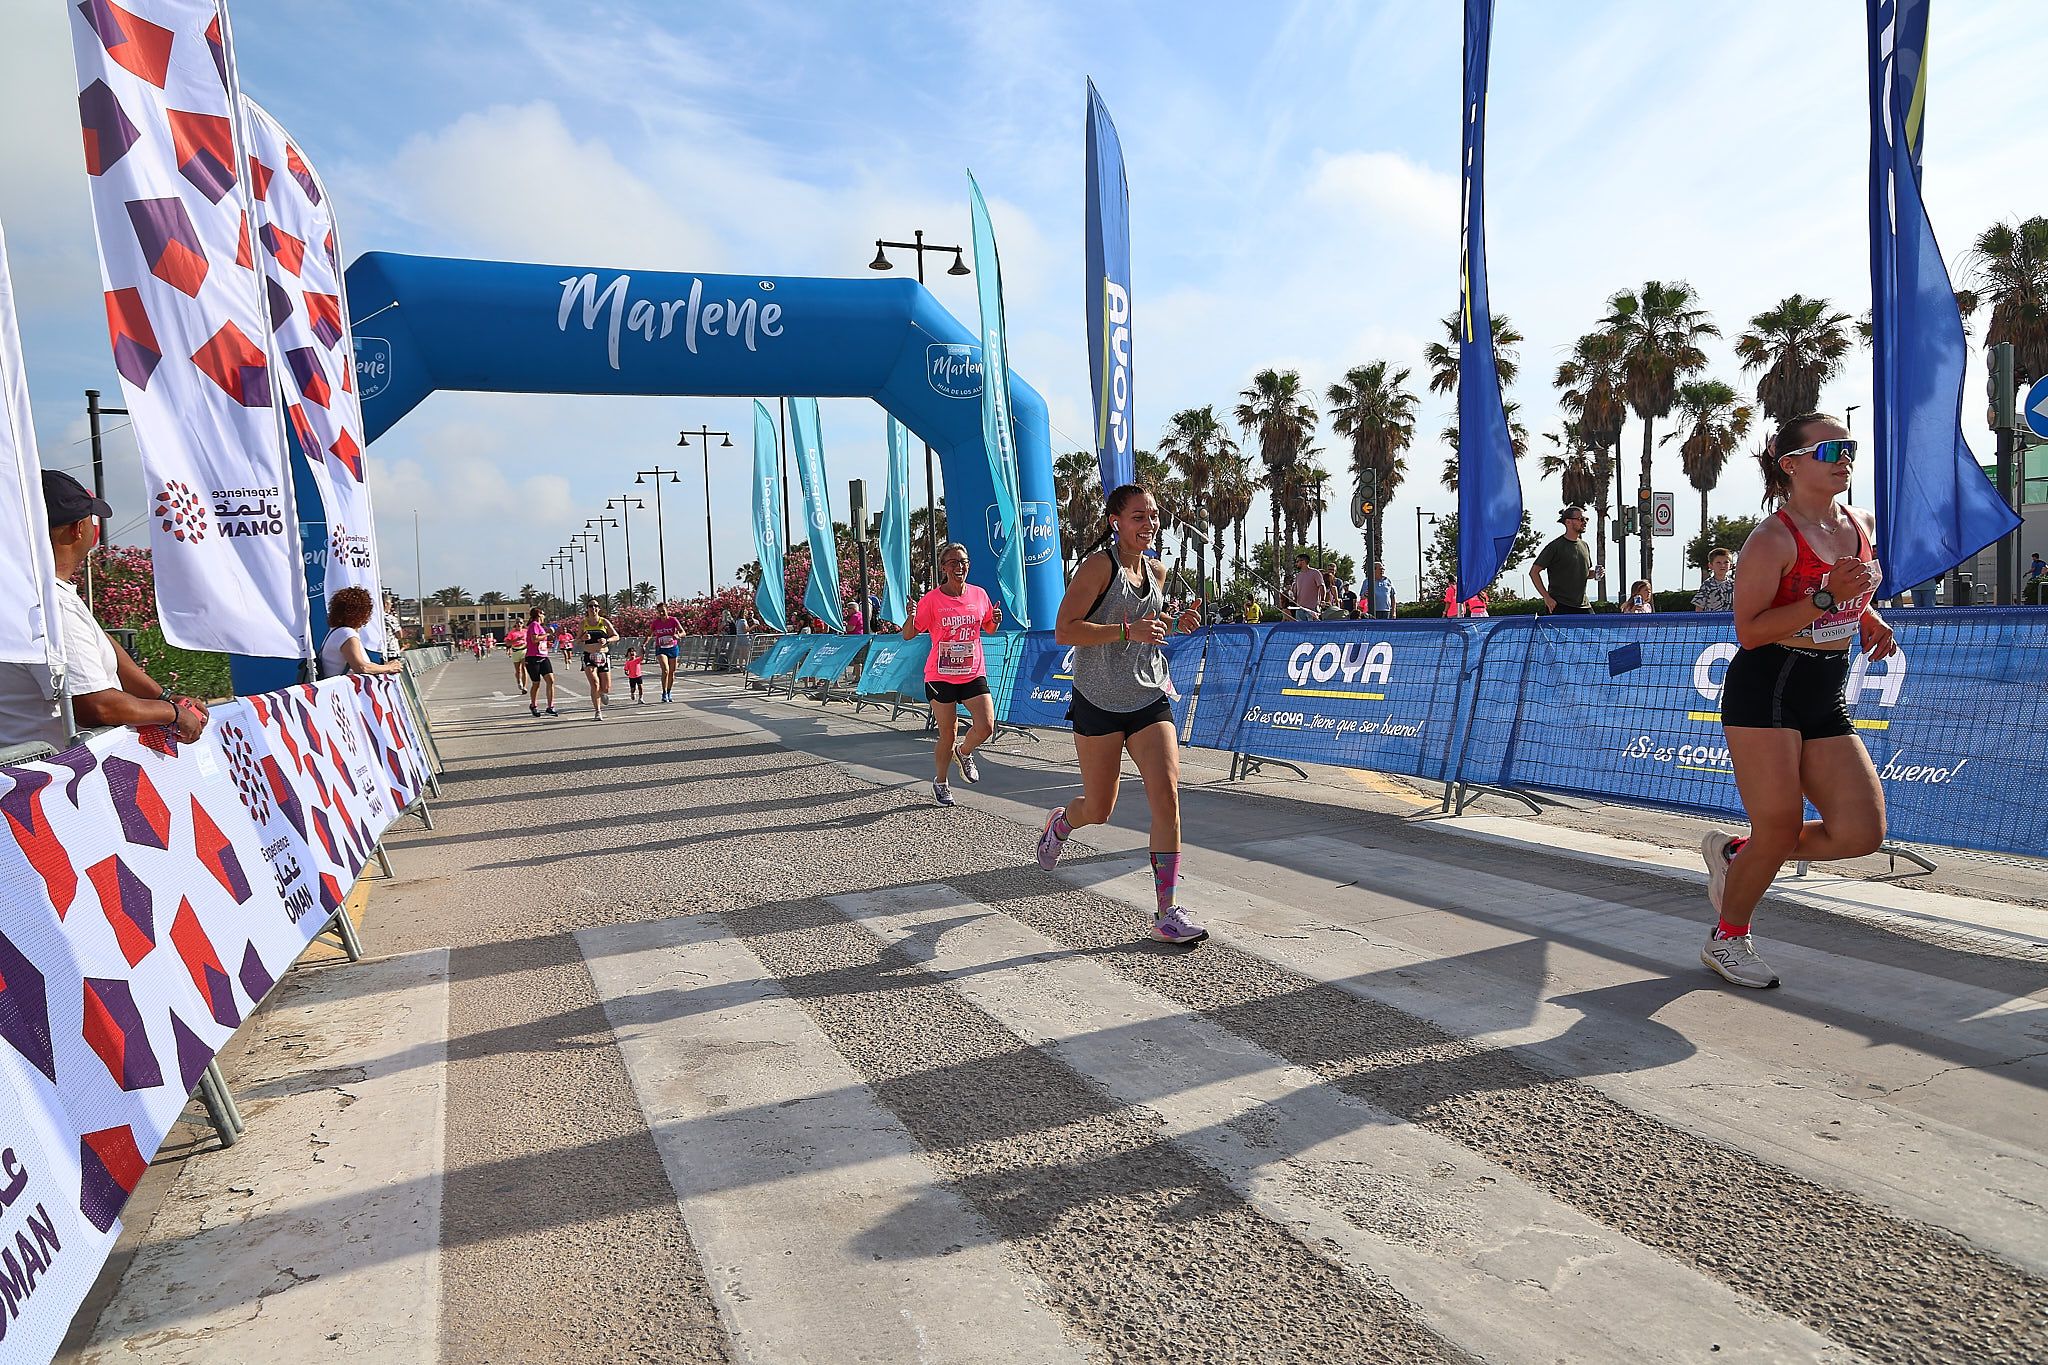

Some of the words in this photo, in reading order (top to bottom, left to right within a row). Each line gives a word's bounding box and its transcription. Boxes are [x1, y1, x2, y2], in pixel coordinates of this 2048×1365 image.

[557, 273, 784, 370] Marlene
[933, 355, 982, 384] Marlen
[1659, 510, 1668, 518] 30
[309, 583, 325, 593] ALP
[942, 615, 976, 627] CARRERA
[1822, 628, 1846, 637] OYSHO
[1287, 641, 1393, 686] GOYA
[1273, 711, 1304, 726] GOYA
[1335, 719, 1356, 740] que
[1359, 720, 1380, 734] ser
[1380, 714, 1425, 738] bueno!
[1653, 747, 1673, 762] es
[1880, 749, 1968, 784] bueno!
[261, 835, 290, 862] Experience
[284, 883, 315, 925] OMAN
